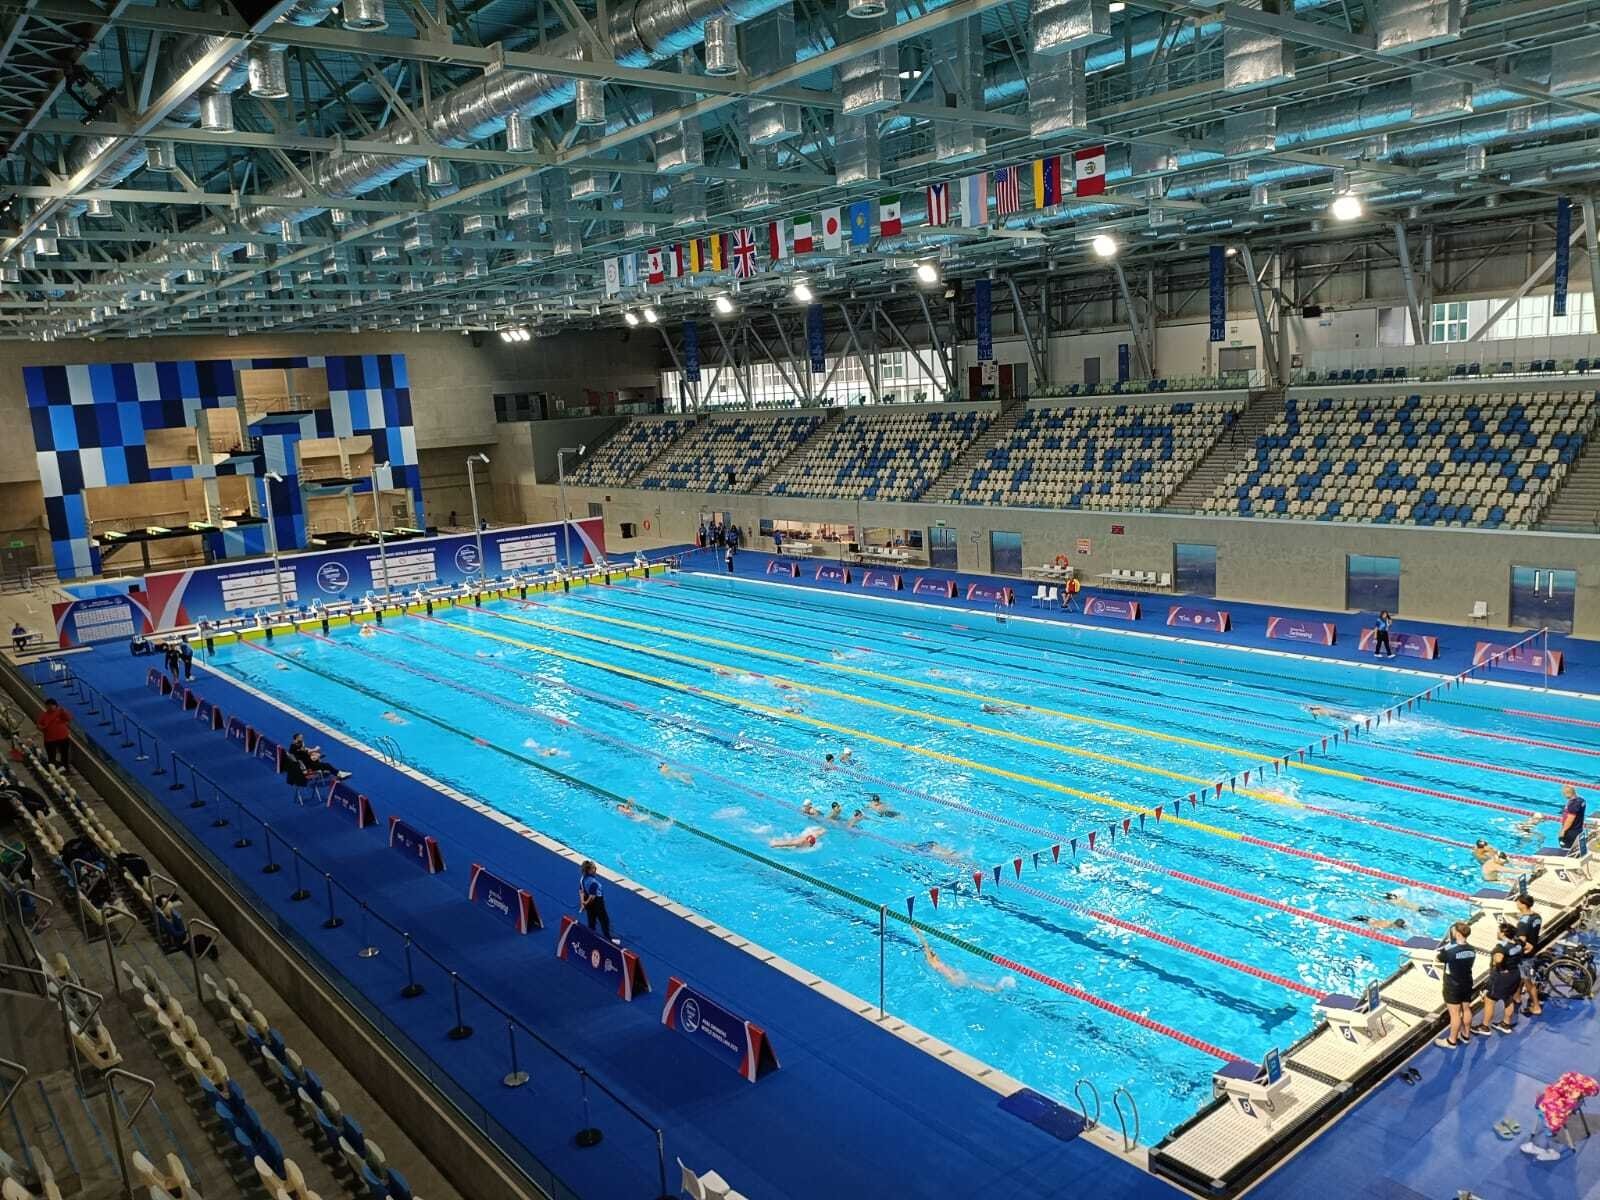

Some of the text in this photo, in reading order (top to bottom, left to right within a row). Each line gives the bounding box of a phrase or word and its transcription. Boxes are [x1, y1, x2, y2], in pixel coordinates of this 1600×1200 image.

[1426, 966, 1434, 976] 7
[1343, 1029, 1351, 1038] 8
[1242, 1102, 1251, 1113] 9
